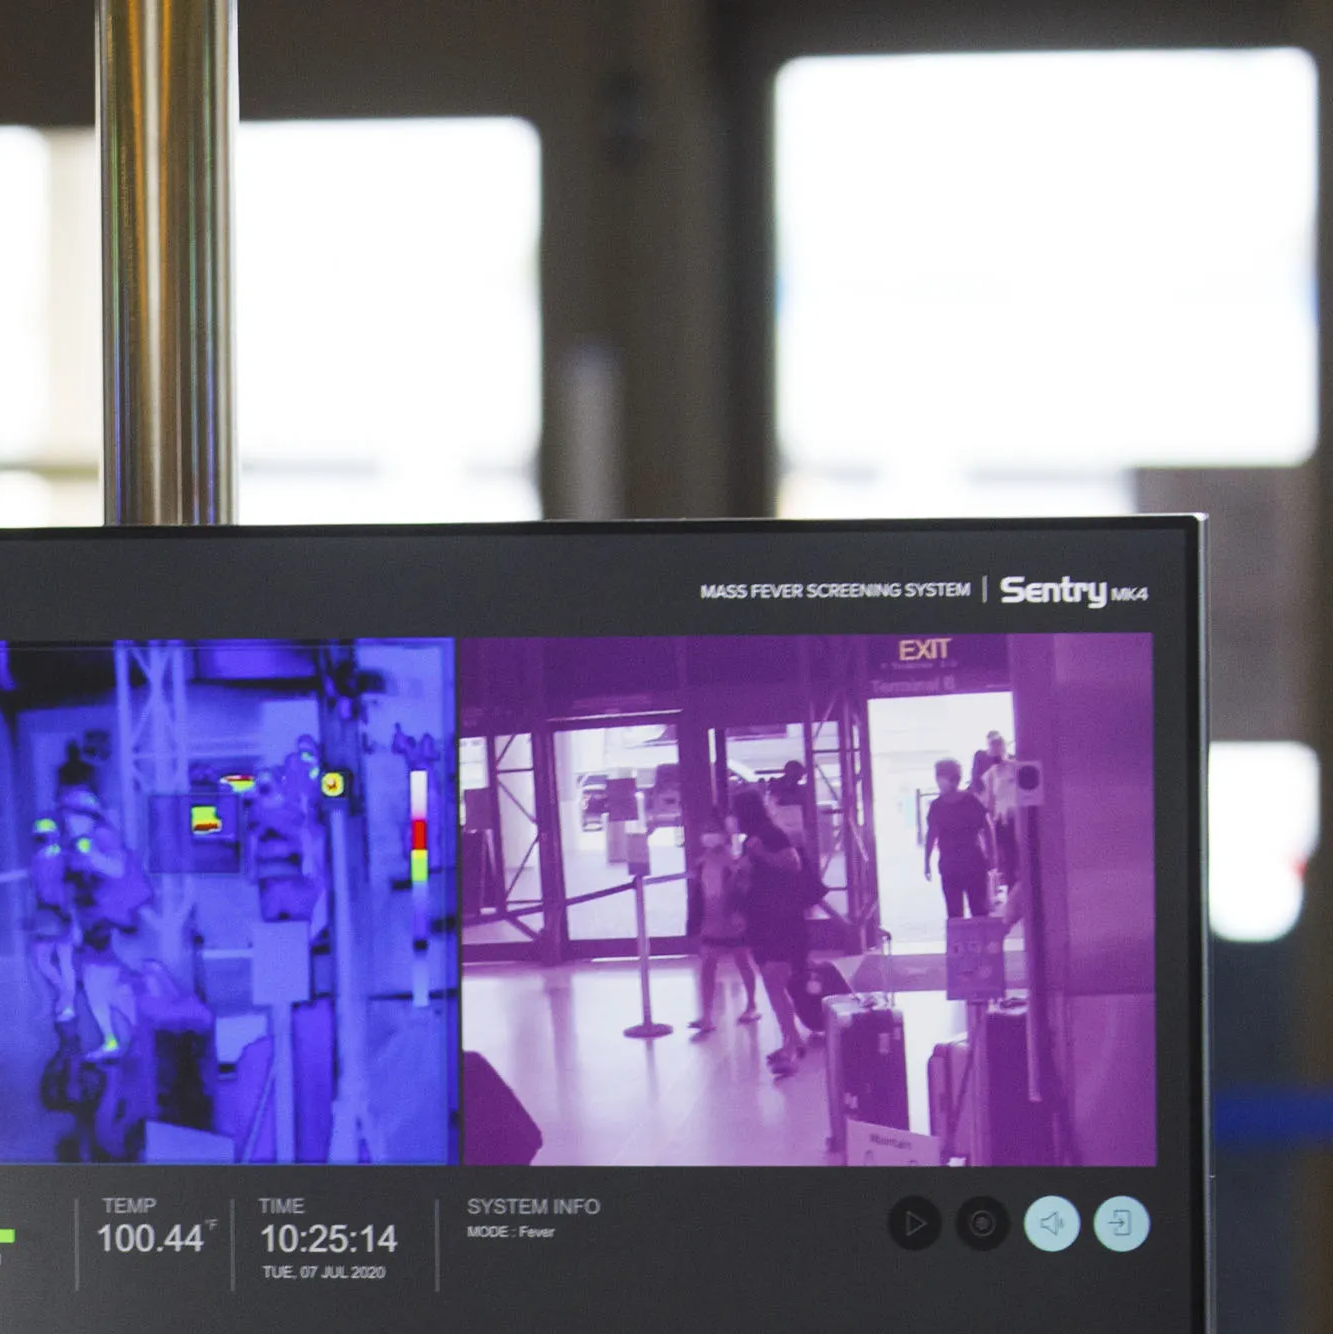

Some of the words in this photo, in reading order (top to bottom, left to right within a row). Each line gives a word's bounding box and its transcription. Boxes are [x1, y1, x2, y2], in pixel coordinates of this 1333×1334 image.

[700, 583, 748, 599] MASS
[750, 583, 804, 599] FEVER
[806, 582, 902, 598] SCREENING
[904, 581, 972, 598] SYSTEM
[1000, 575, 1108, 609] Sentry
[1111, 587, 1149, 601] MK4
[898, 637, 952, 661] EXIT
[102, 1197, 157, 1214] TEMP
[259, 1198, 306, 1214] TIME
[467, 1198, 549, 1215] SYSTEM
[553, 1198, 601, 1215] INFO
[261, 1224, 398, 1253] 10:25:14
[467, 1226, 509, 1238] MODE
[519, 1225, 555, 1238] Fever
[263, 1265, 297, 1280] TUE,
[300, 1265, 319, 1279] 07
[321, 1265, 348, 1279] JUL
[350, 1265, 386, 1279] 2020
